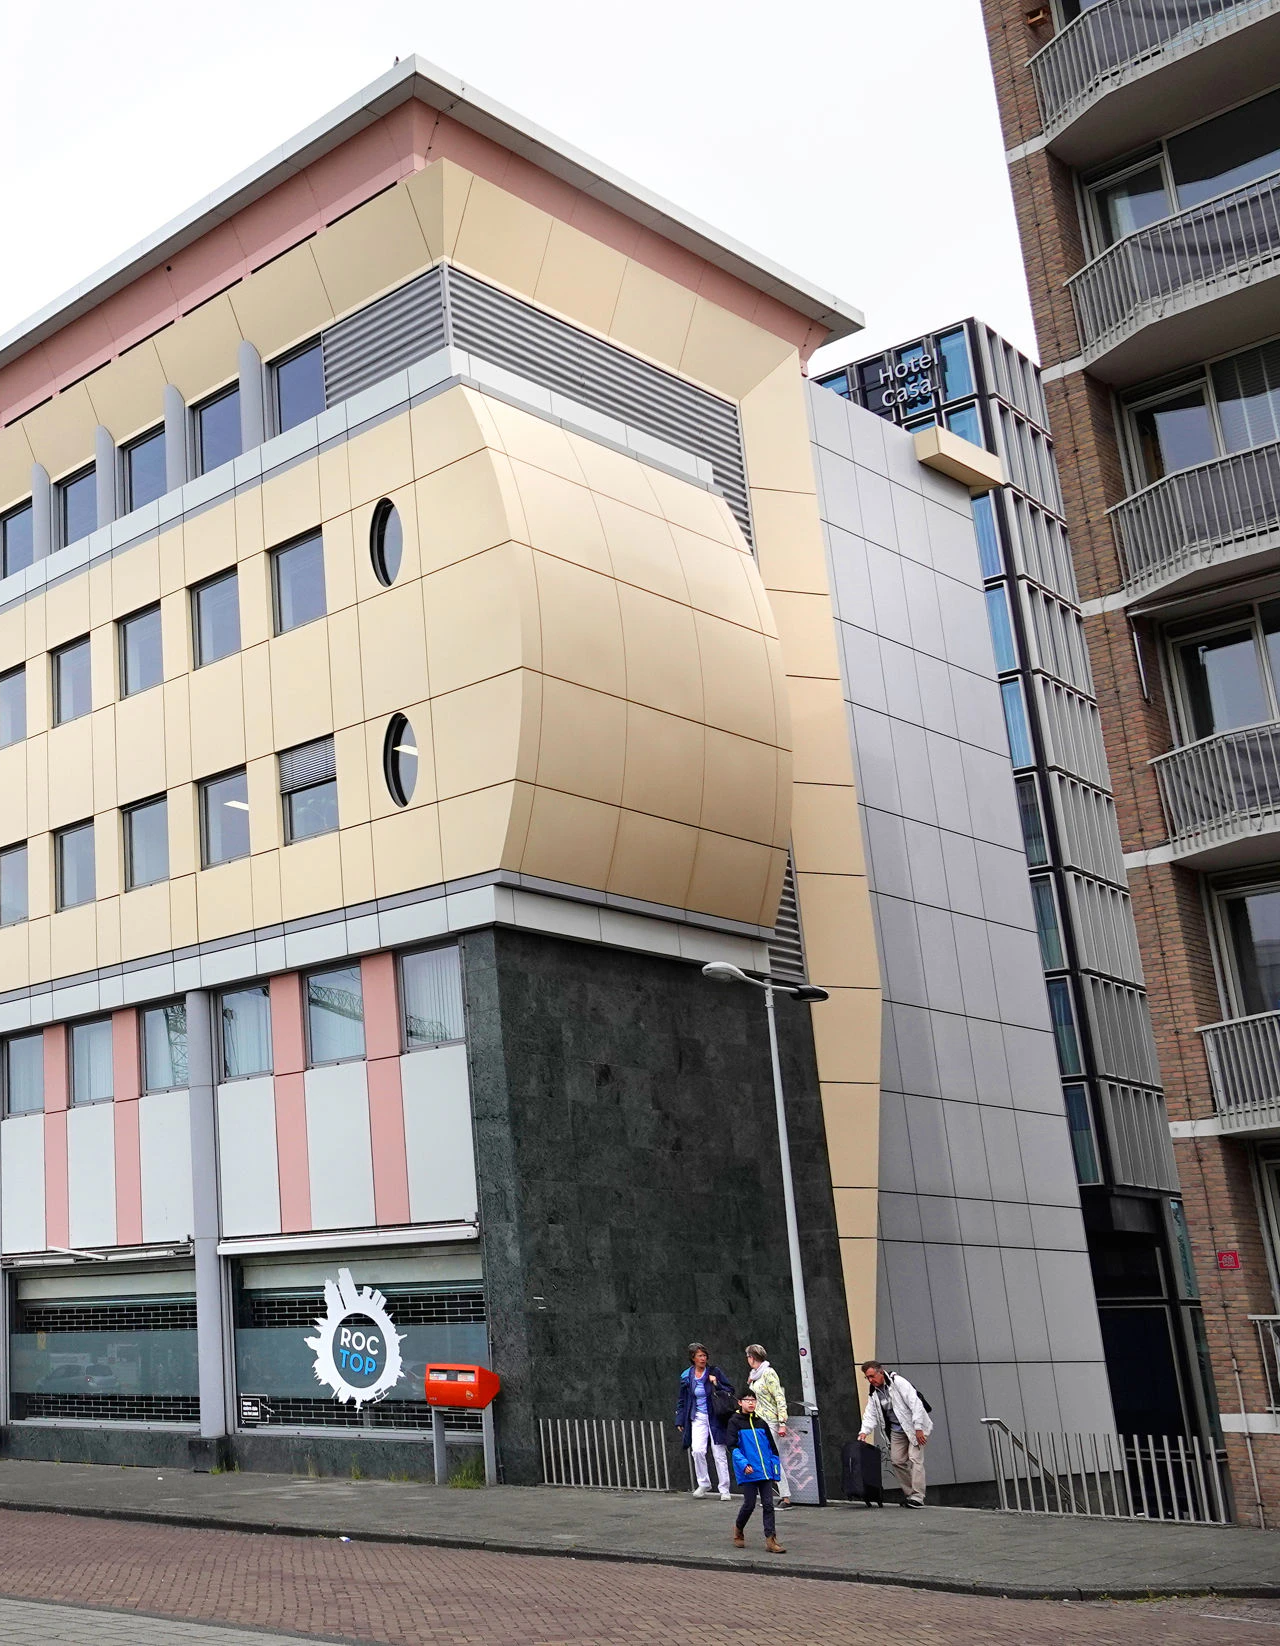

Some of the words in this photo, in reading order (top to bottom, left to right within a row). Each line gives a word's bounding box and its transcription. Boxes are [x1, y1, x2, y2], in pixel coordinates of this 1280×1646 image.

[878, 347, 939, 385] Hotel
[881, 378, 933, 407] Casa
[340, 1327, 380, 1355] ROC
[339, 1348, 377, 1375] TOP
